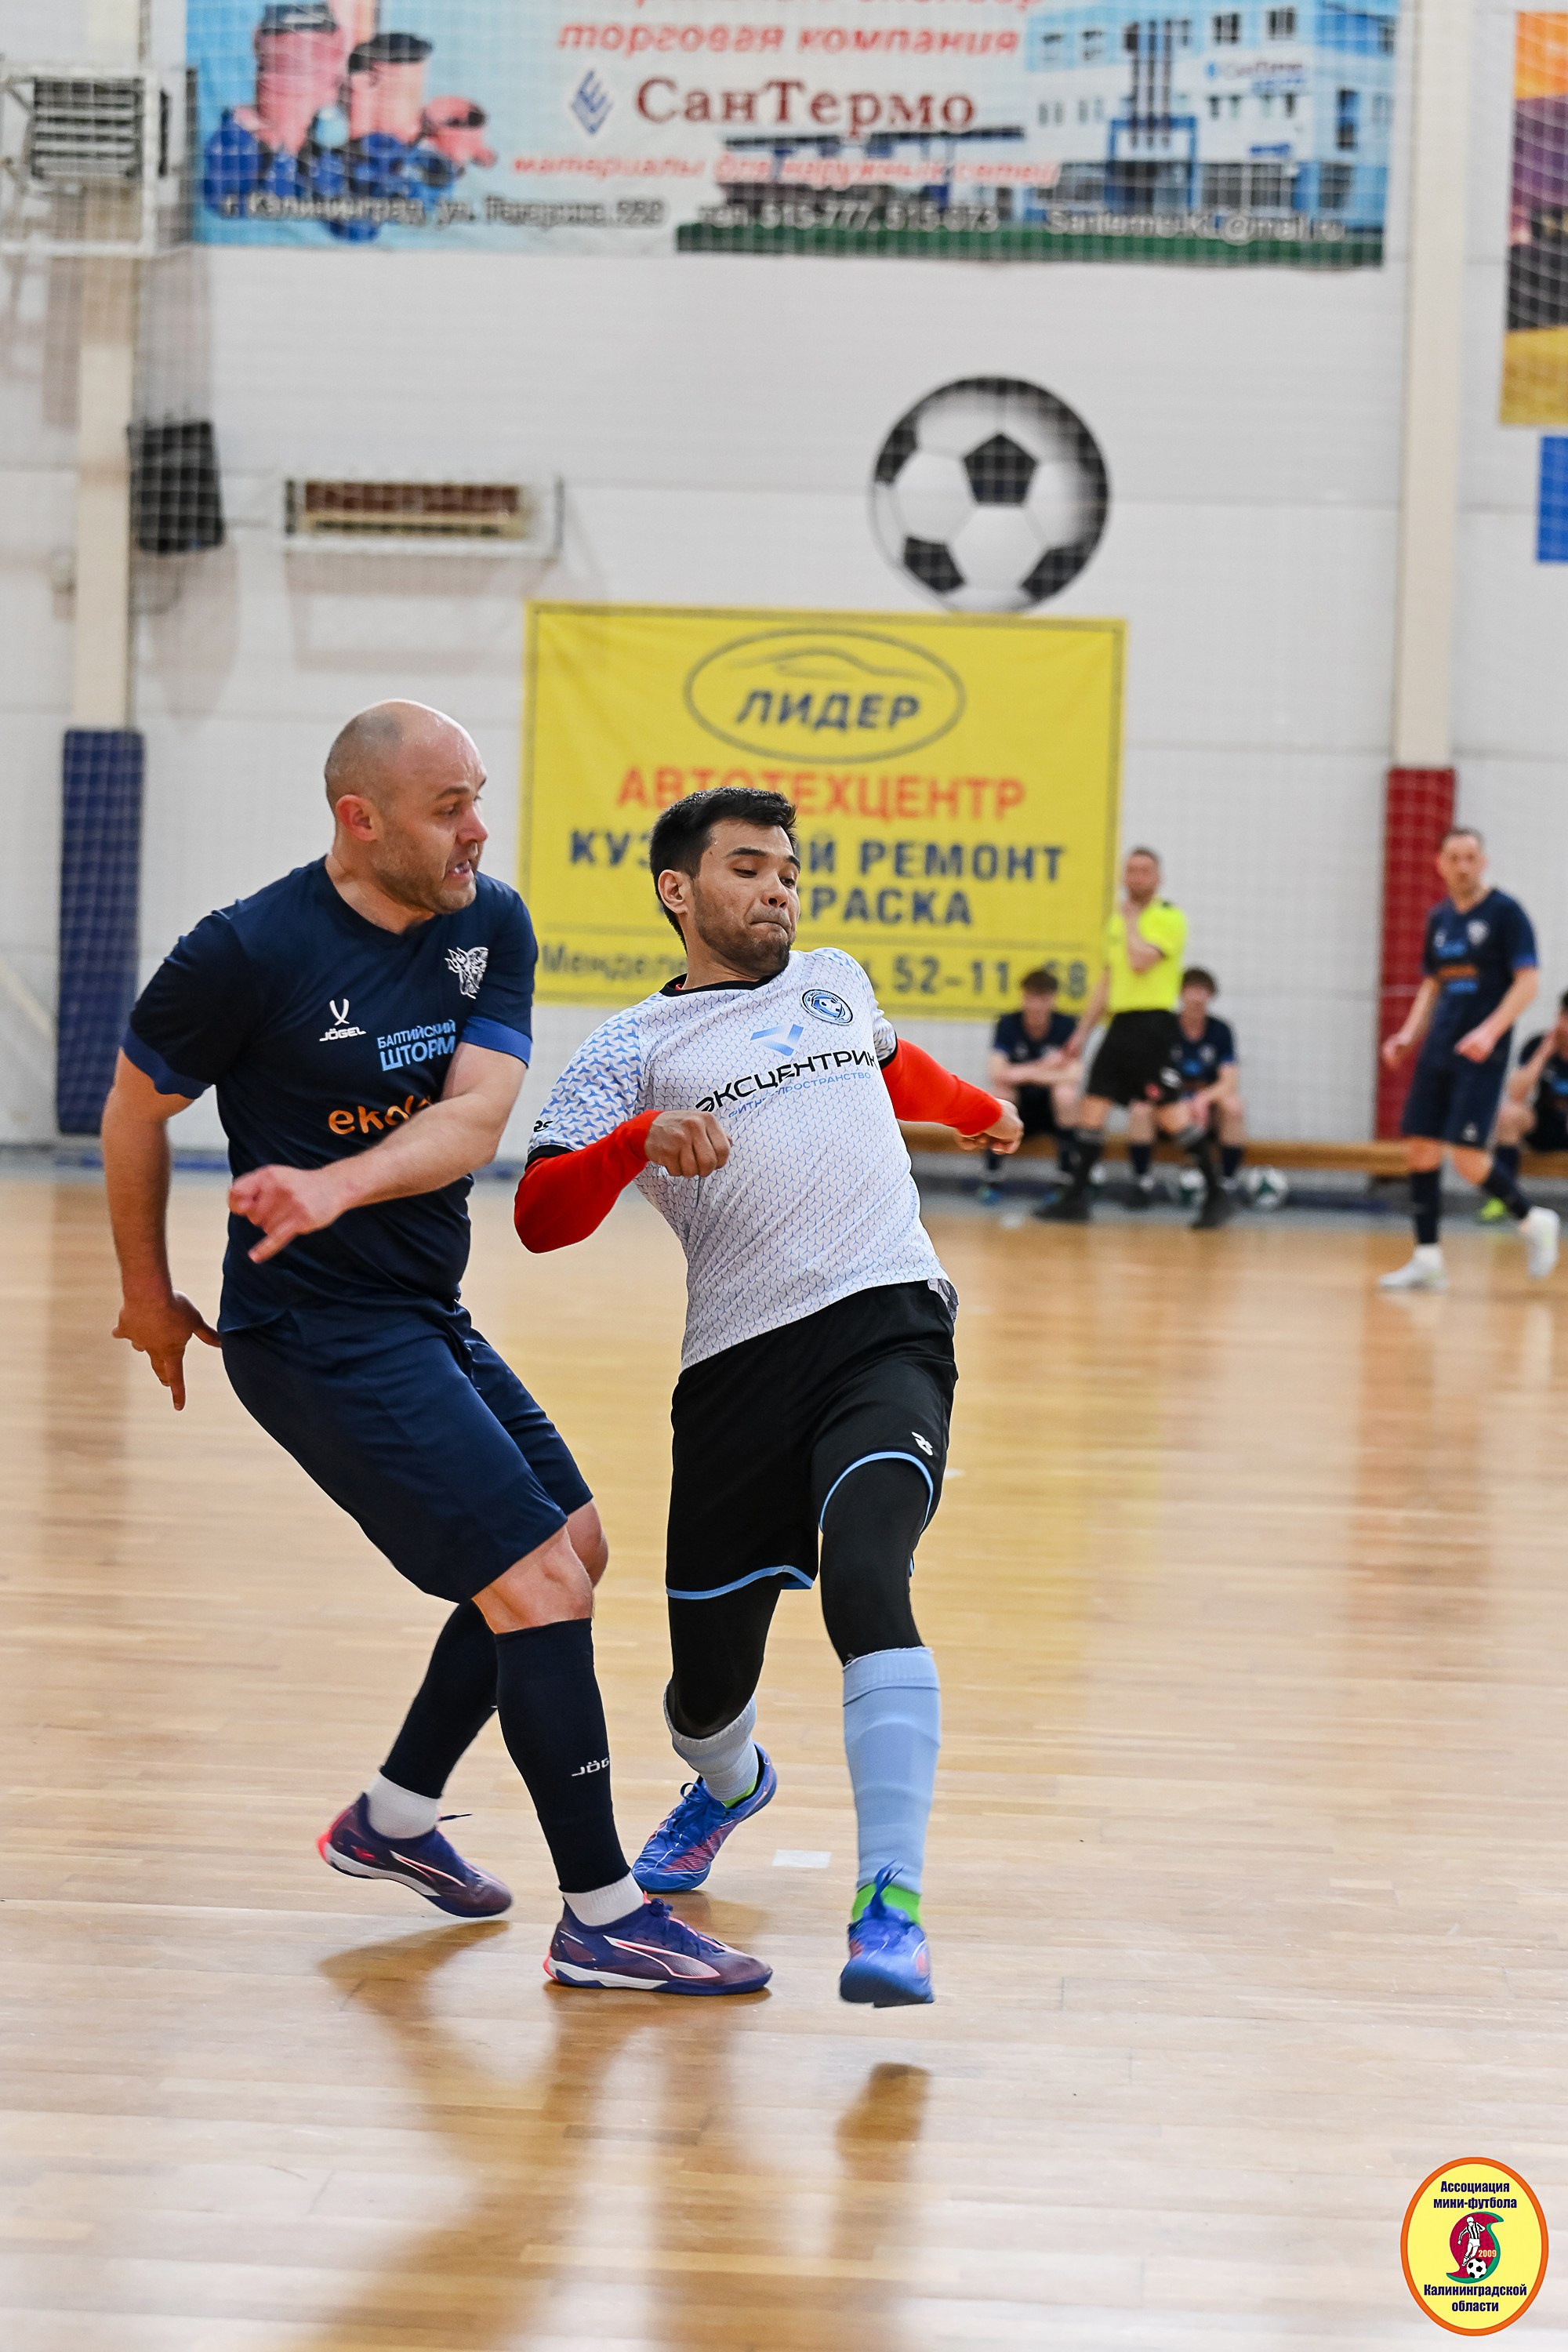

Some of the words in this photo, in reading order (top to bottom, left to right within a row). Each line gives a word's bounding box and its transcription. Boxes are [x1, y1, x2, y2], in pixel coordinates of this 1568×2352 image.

[558, 24, 784, 57] торговая
[798, 27, 1021, 55] компания
[633, 77, 978, 140] СанТермо
[735, 688, 921, 731] ЛИДЕР
[860, 839, 1066, 882] РЕМОНТ
[319, 1025, 367, 1042] JÖGEL
[376, 1019, 457, 1050] БАЛТИЙСКИЙ
[379, 1036, 456, 1072] ШТОРМ
[571, 1757, 610, 1777] JÖG
